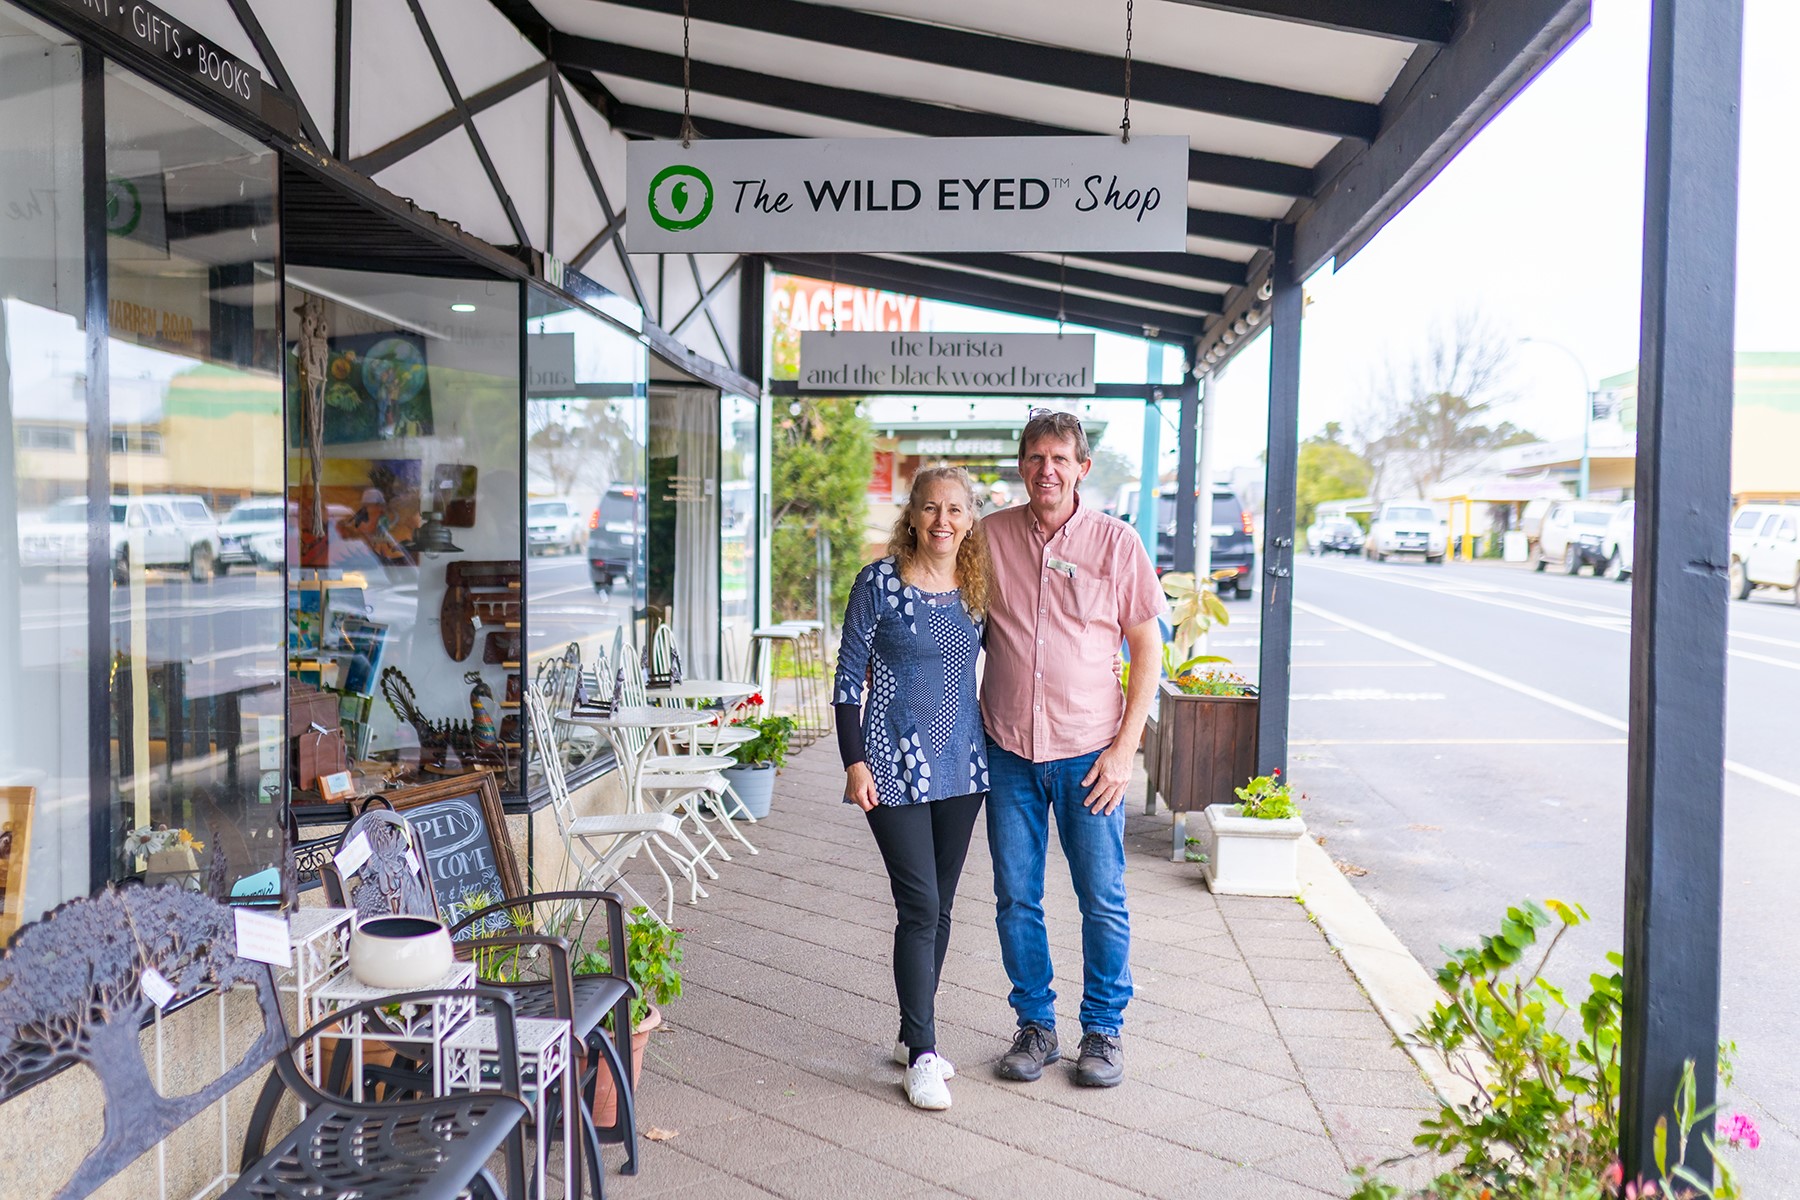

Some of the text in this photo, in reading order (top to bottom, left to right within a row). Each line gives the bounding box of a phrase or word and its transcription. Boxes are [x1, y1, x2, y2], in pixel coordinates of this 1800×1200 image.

[132, 5, 250, 100] GIFTS BOOKS
[732, 178, 794, 214] The
[803, 179, 922, 212] WILD
[1075, 174, 1161, 222] Shop
[890, 335, 1003, 358] the barista
[806, 363, 849, 386] and
[853, 363, 886, 386] the
[1021, 366, 1086, 388] bread
[917, 438, 1004, 454] POST OFFICE
[414, 811, 469, 840] PEN
[433, 846, 492, 882] COME
